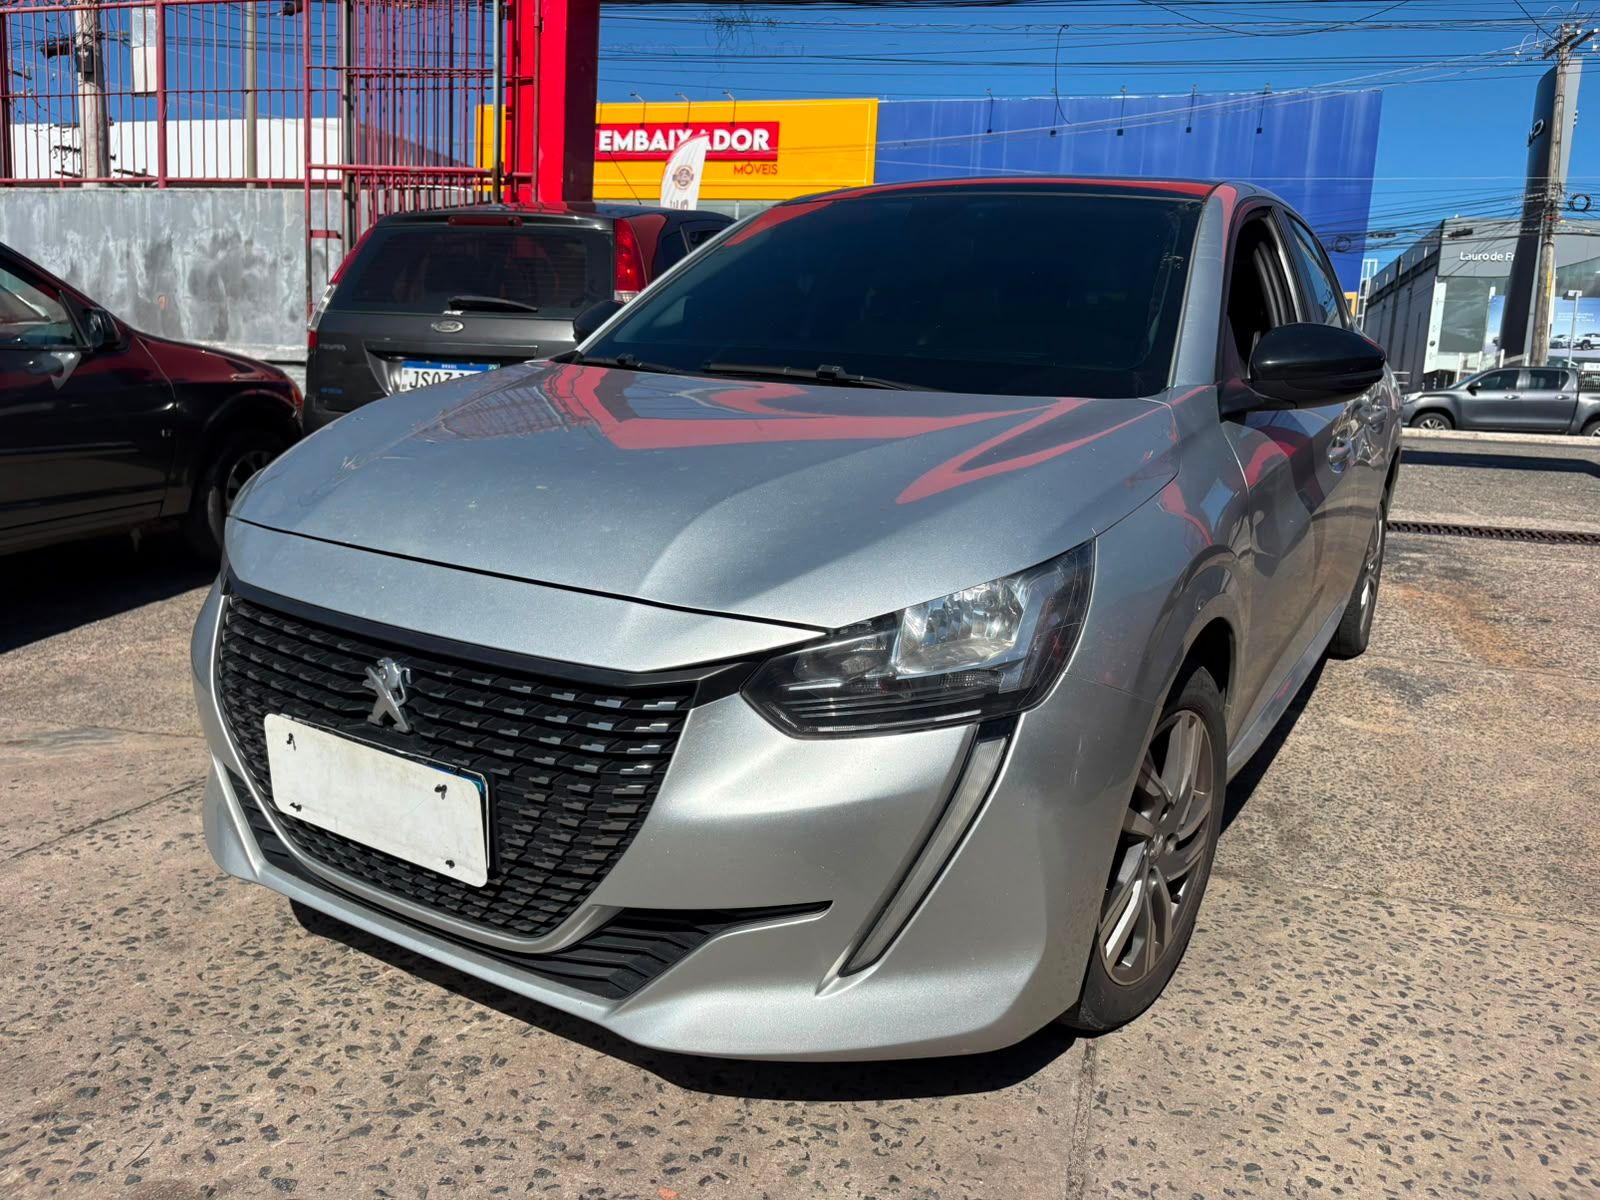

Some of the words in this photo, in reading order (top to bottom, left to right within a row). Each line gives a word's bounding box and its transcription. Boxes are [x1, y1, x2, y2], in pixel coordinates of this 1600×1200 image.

[733, 160, 778, 175] MÓVEIS
[1460, 251, 1490, 261] Lauro
[1490, 251, 1504, 261] de
